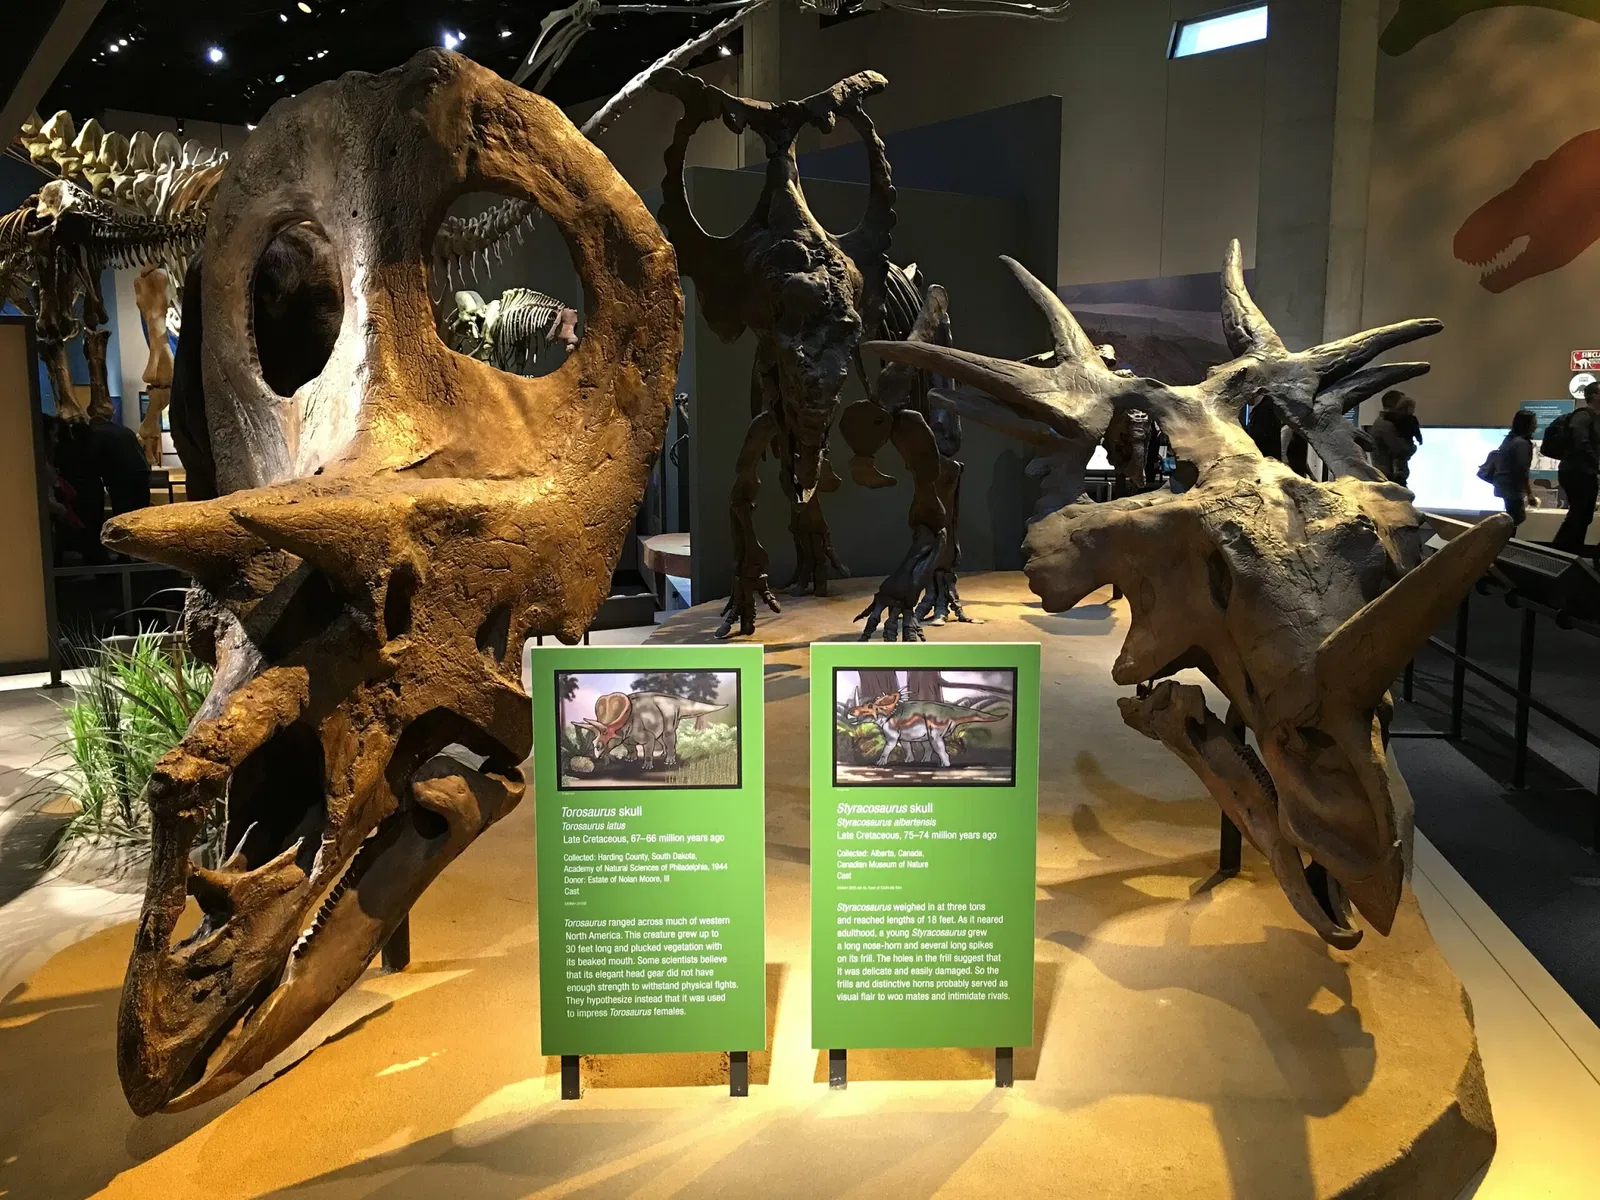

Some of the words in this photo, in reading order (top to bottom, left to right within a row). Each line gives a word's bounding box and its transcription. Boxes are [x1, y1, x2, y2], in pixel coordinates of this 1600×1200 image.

[562, 805, 616, 818] Torosaurus
[619, 805, 642, 817] skull
[837, 803, 908, 815] Styracosaurus
[910, 803, 933, 814] skull
[563, 821, 604, 831] Torosaurus
[607, 821, 627, 831] latus
[837, 818, 892, 828] Styracosaurus
[894, 818, 936, 827] albertensis
[564, 835, 580, 844] Late
[583, 834, 628, 844] Cretaceous,
[659, 833, 684, 842] million
[687, 834, 708, 843] years
[710, 833, 726, 843] ago
[837, 831, 854, 840] Late
[856, 831, 901, 840] Cretaceous,
[932, 831, 957, 839] million
[959, 832, 980, 842] years
[982, 832, 997, 842] ago
[564, 853, 596, 862] Collected:
[598, 853, 623, 862] Harding
[625, 852, 649, 862] County,
[652, 852, 671, 860] South
[673, 851, 698, 861] Dakota,
[837, 849, 868, 858] Collected:
[871, 849, 896, 857] Alberta,
[898, 849, 924, 857] Canada,
[564, 864, 594, 874] Academy
[596, 864, 602, 872] of
[604, 864, 628, 872] Natural
[630, 863, 659, 872] Sciences
[669, 862, 709, 872] Philadelphia,
[712, 862, 729, 871] 1944
[837, 860, 867, 869] Canadian
[869, 860, 897, 868] Museum
[899, 860, 905, 868] of
[907, 860, 929, 868] Nature
[564, 876, 586, 884] Donor:
[588, 875, 608, 884] Estate
[610, 875, 617, 883] of
[619, 875, 638, 883] Nolan
[639, 874, 662, 883] Moore,
[837, 871, 852, 880] Cast
[837, 903, 892, 913] Styracosaurus
[893, 903, 926, 913] weighed
[928, 903, 935, 911] in
[937, 903, 945, 911] at
[947, 903, 967, 911] three
[970, 903, 986, 911] tons
[565, 918, 606, 928] Torosaurus
[609, 918, 636, 928] ranged
[638, 918, 663, 926] across
[666, 917, 687, 926] much
[689, 916, 697, 925] of
[699, 915, 731, 926] western
[837, 916, 852, 925] and
[854, 916, 885, 924] reached
[887, 916, 915, 926] lengths
[917, 915, 925, 924] of
[928, 915, 937, 924] 18
[939, 915, 956, 924] feet.
[958, 915, 968, 924] As
[970, 915, 975, 924] it
[977, 915, 1003, 924] neared
[566, 931, 587, 941] North
[589, 931, 623, 940] America.
[625, 930, 641, 939] This
[643, 930, 676, 939] creature
[678, 931, 697, 940] grew
[699, 930, 710, 939] up
[711, 928, 719, 938] to
[837, 928, 877, 938] adulthood,
[886, 929, 910, 939] young
[912, 928, 967, 938] Styracosaurus
[968, 929, 987, 939] grew
[566, 944, 576, 954] 30
[578, 944, 593, 953] feet
[596, 944, 612, 954] long
[614, 944, 628, 953] and
[631, 943, 661, 953] plucked
[664, 942, 704, 952] vegetation
[706, 941, 723, 952] with
[837, 942, 843, 951] a
[844, 941, 861, 952] long
[863, 941, 902, 950] nose-horn
[904, 941, 918, 950] and
[920, 941, 948, 950] several
[950, 941, 967, 951] long
[969, 941, 993, 950] spikes
[567, 958, 575, 966] its
[578, 957, 606, 966] beaked
[609, 956, 635, 966] mouth.
[638, 955, 659, 965] Some
[662, 955, 698, 964] scientists
[700, 954, 728, 964] believe
[837, 955, 847, 964] on
[849, 954, 858, 963] its
[860, 954, 874, 962] frill.
[877, 954, 891, 962] The
[893, 954, 914, 962] holes
[925, 954, 937, 962] the
[940, 954, 952, 962] frill
[954, 954, 984, 964] suggest
[986, 954, 1001, 962] that
[566, 971, 581, 979] that
[584, 970, 593, 979] its
[595, 969, 624, 979] elegant
[626, 969, 645, 978] head
[647, 970, 664, 979] gear
[667, 968, 678, 977] did
[681, 968, 693, 977] not
[695, 967, 714, 977] have
[837, 966, 842, 975] it
[844, 968, 860, 976] was
[862, 967, 892, 976] delicate
[894, 967, 908, 975] and
[911, 967, 933, 976] easily
[935, 966, 972, 976] damaged.
[975, 966, 985, 975] So
[987, 966, 999, 975] the
[567, 983, 595, 993] enough
[598, 982, 629, 992] strength
[632, 982, 639, 991] to
[642, 981, 679, 990] withstand
[682, 980, 713, 991] physical
[715, 980, 739, 990] fights.
[837, 979, 853, 989] frills
[856, 980, 870, 988] and
[872, 980, 910, 988] distinctive
[913, 980, 934, 988] horns
[937, 979, 969, 989] probably
[972, 979, 997, 988] served
[999, 980, 1008, 988] as
[566, 996, 584, 1006] They
[587, 995, 632, 1005] hypothesize
[635, 994, 662, 1004] instead
[665, 994, 680, 1003] that
[682, 994, 687, 1002] it
[707, 993, 726, 1003] used
[837, 992, 859, 1001] visual
[861, 992, 876, 1001] flair
[878, 993, 885, 1001] to
[887, 993, 904, 1001] woo
[906, 992, 929, 1001] mates
[932, 992, 946, 1000] and
[948, 992, 986, 1000] intimidate
[988, 992, 1010, 1000] rivals.
[567, 1009, 575, 1018] to
[577, 1008, 608, 1018] impress
[611, 1007, 652, 1017] Torosaurus
[654, 1007, 687, 1016] females.
